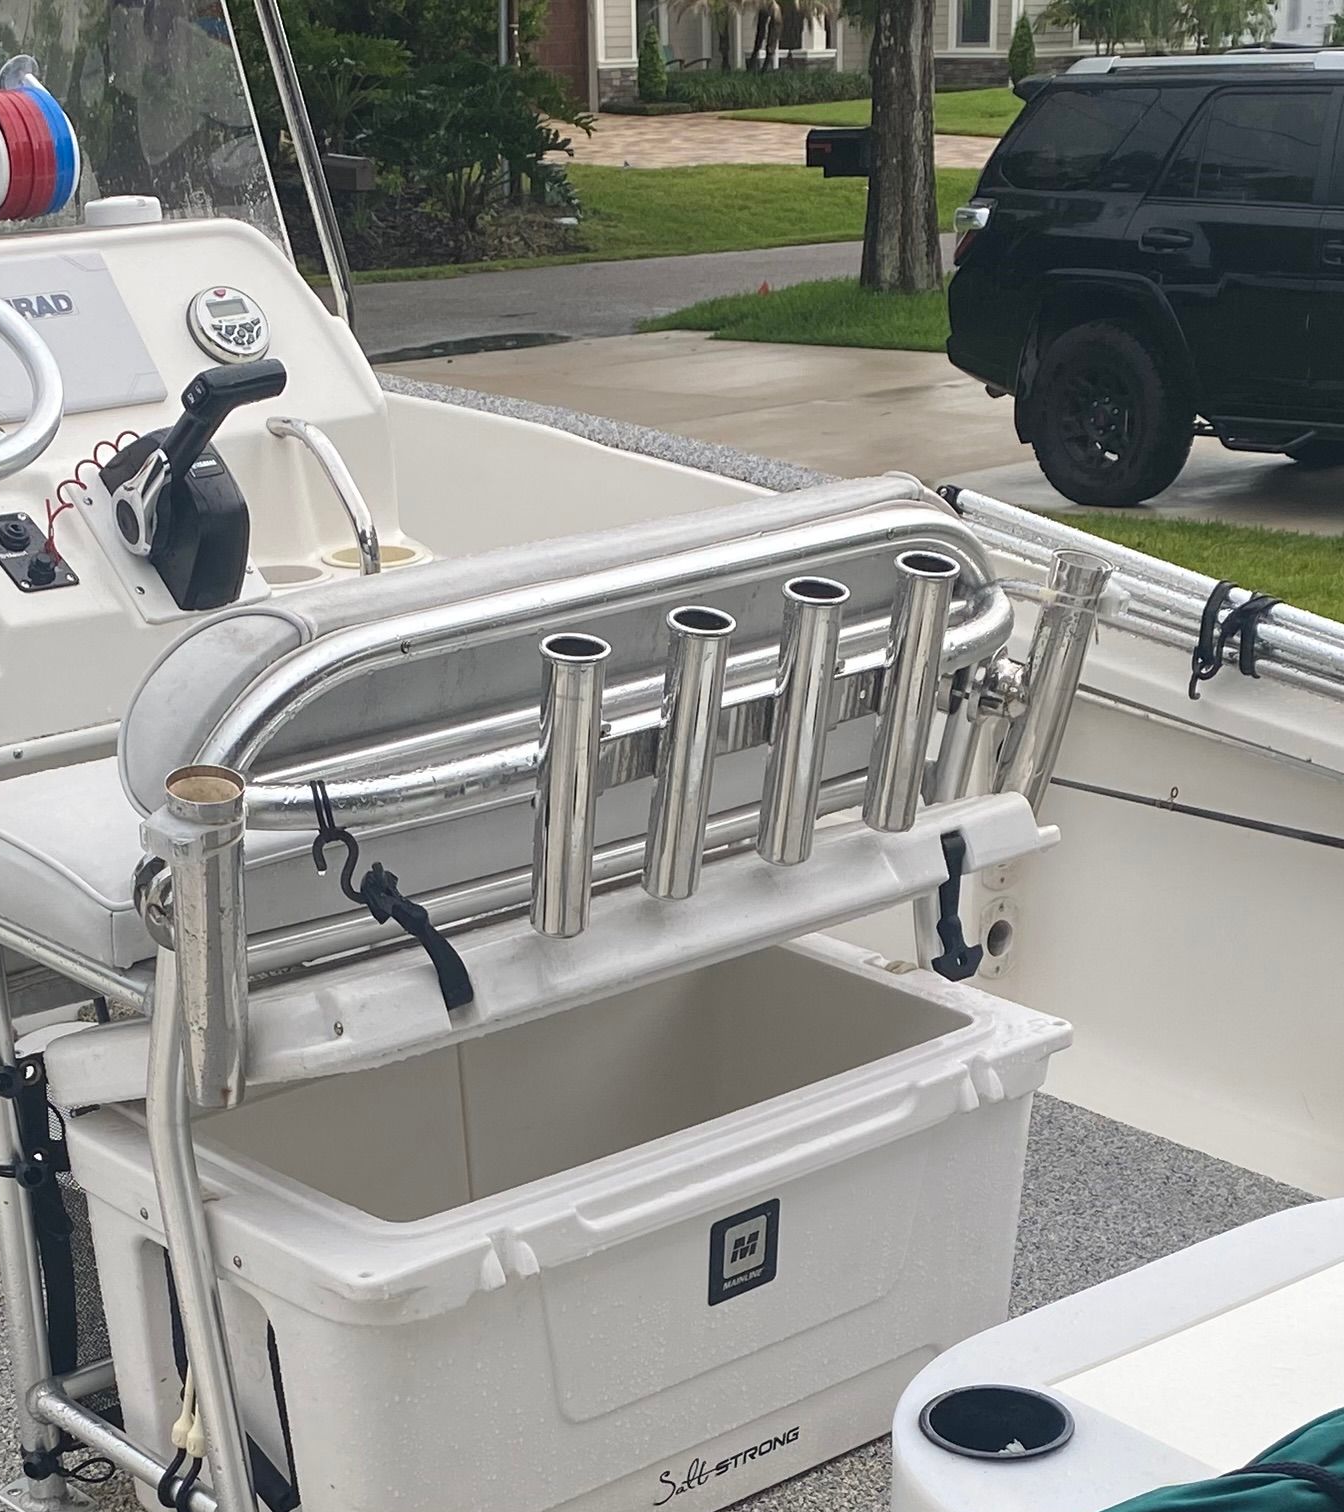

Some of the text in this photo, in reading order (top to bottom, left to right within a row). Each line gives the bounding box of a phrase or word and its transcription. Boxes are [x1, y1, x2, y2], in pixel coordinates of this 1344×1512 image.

[4, 294, 73, 319] RAD
[722, 1267, 764, 1291] MAINLINE
[653, 1425, 800, 1506] Salt STRONG
